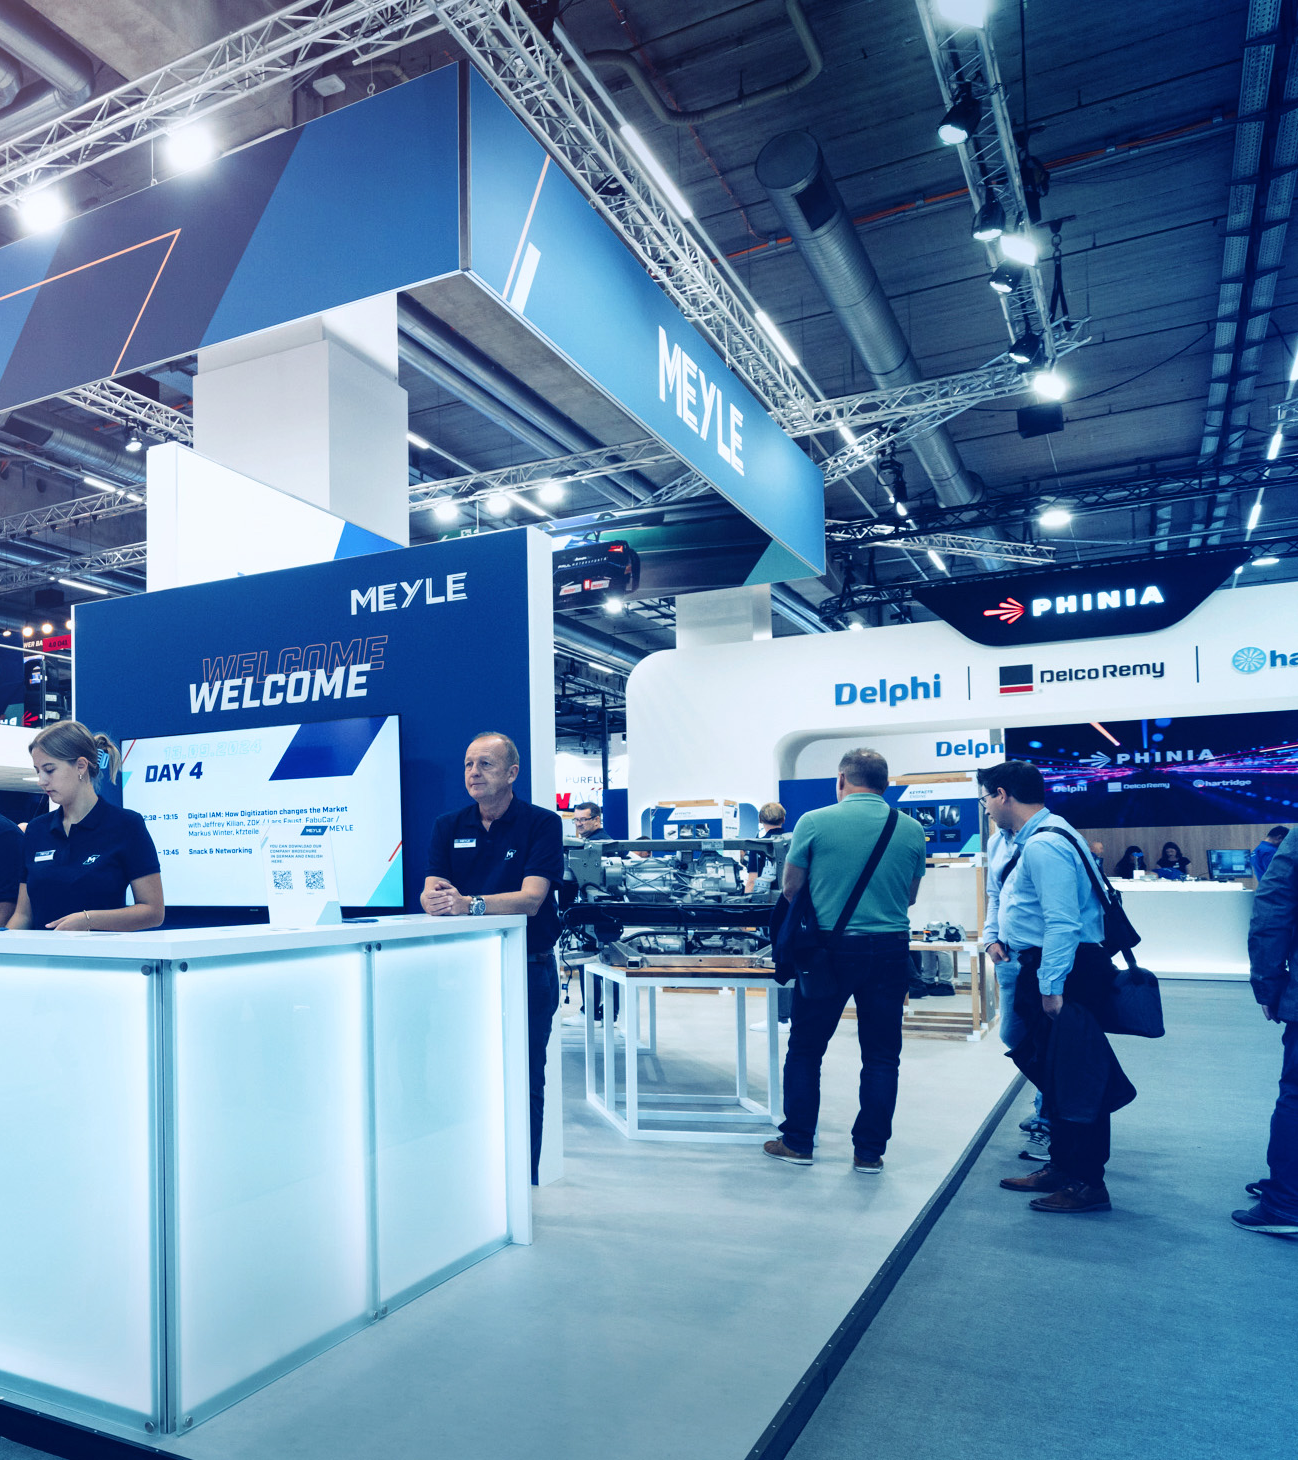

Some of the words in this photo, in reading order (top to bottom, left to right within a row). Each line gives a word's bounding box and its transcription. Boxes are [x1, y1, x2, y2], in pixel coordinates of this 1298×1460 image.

[659, 325, 744, 477] MEYLE
[350, 572, 468, 615] MEYLE
[1032, 585, 1165, 617] PHINIA
[203, 635, 388, 690] WELCOME
[189, 663, 371, 714] WELCOME
[835, 674, 942, 707] Delphi
[936, 740, 1005, 758] Delph
[1116, 749, 1215, 765] PHINIA
[145, 763, 185, 782] DAY
[189, 761, 203, 779] 4
[1052, 784, 1087, 793] Delphi
[1204, 779, 1251, 788] hartridge
[187, 812, 208, 820] Digital
[240, 809, 278, 818] Digitization
[322, 805, 348, 813] Market
[202, 821, 225, 829] Jeffrey
[305, 816, 334, 824] FabuCar
[212, 829, 235, 837] Winter,
[329, 824, 354, 832] MEYLE
[163, 848, 180, 856] 13:45
[215, 847, 253, 855] Networking
